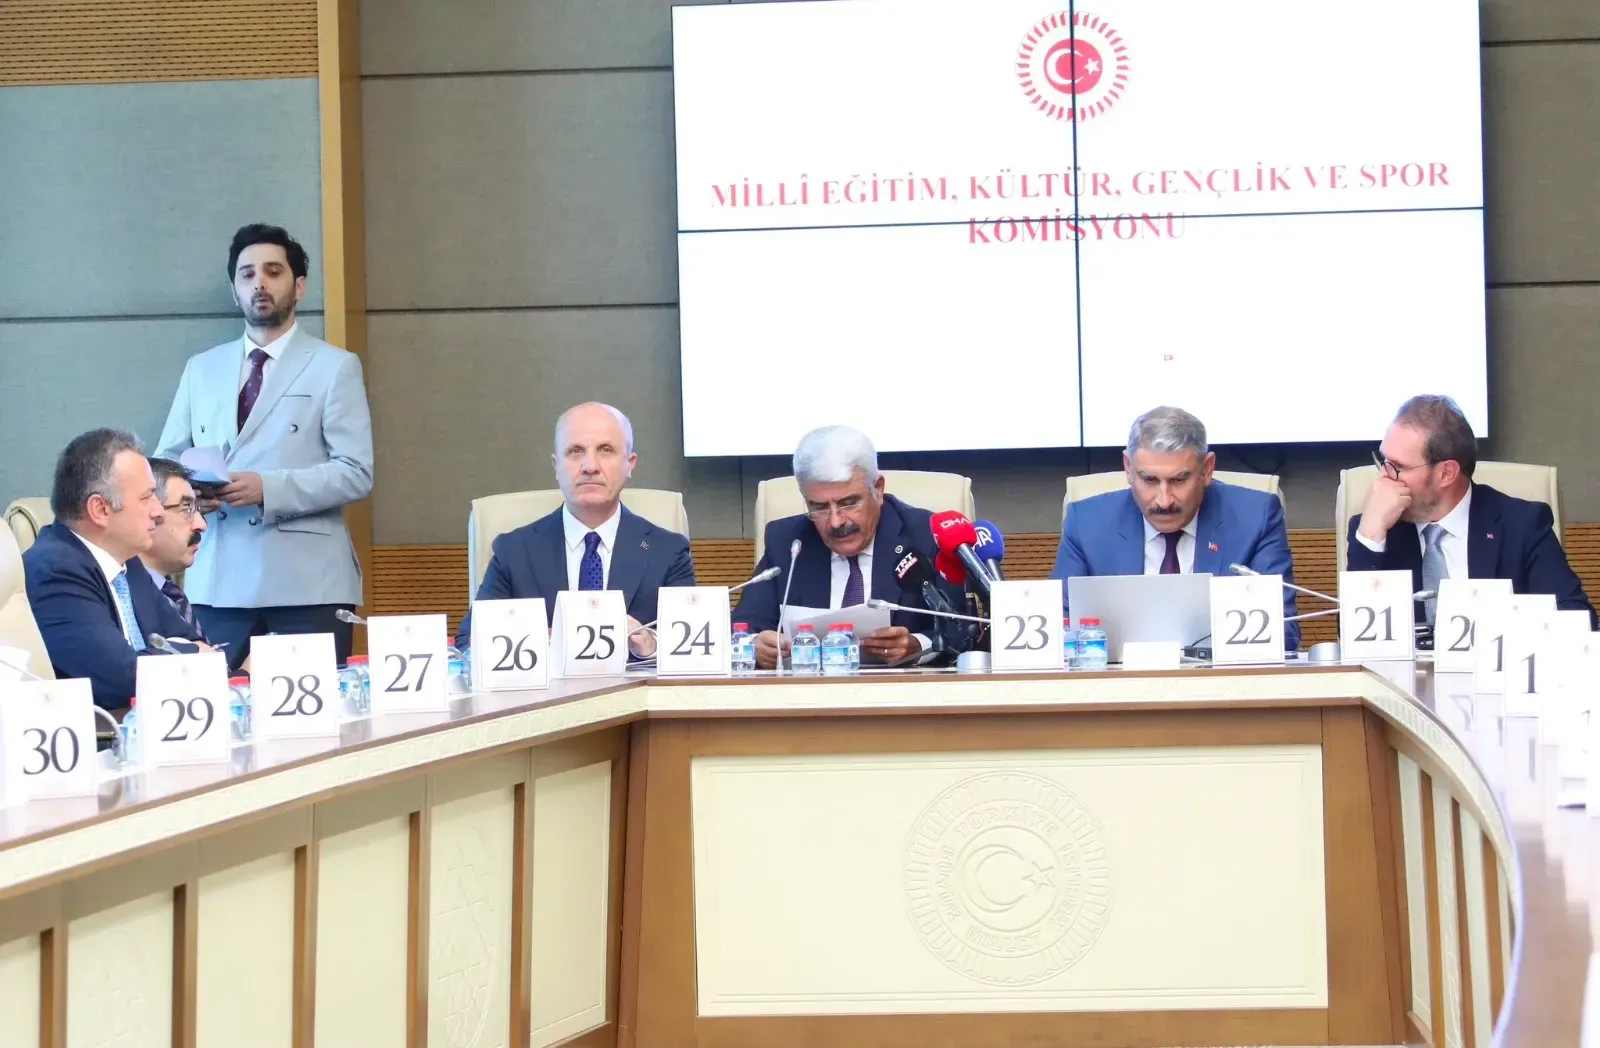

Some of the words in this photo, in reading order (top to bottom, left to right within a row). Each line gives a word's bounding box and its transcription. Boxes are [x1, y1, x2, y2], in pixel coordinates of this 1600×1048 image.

[711, 173, 809, 208] MİLLÎ
[822, 172, 958, 205] EĞİTİM,
[969, 166, 1122, 200] KÜLTÜR,
[1131, 161, 1292, 198] GENÇLİK
[1303, 165, 1348, 189] VE
[1360, 162, 1450, 188] SPOR
[968, 208, 1187, 244] KOMİSYONU
[895, 552, 913, 572] TRT
[574, 624, 615, 660] 25
[670, 620, 715, 656] 24
[1003, 614, 1049, 650] 23
[1225, 609, 1271, 645] 22
[1353, 606, 1397, 642] 21
[1447, 615, 1476, 652] 2
[491, 634, 538, 672] 26
[384, 653, 433, 693] 27
[271, 674, 323, 717] 28
[160, 697, 214, 742] 29
[22, 726, 79, 776] 30
